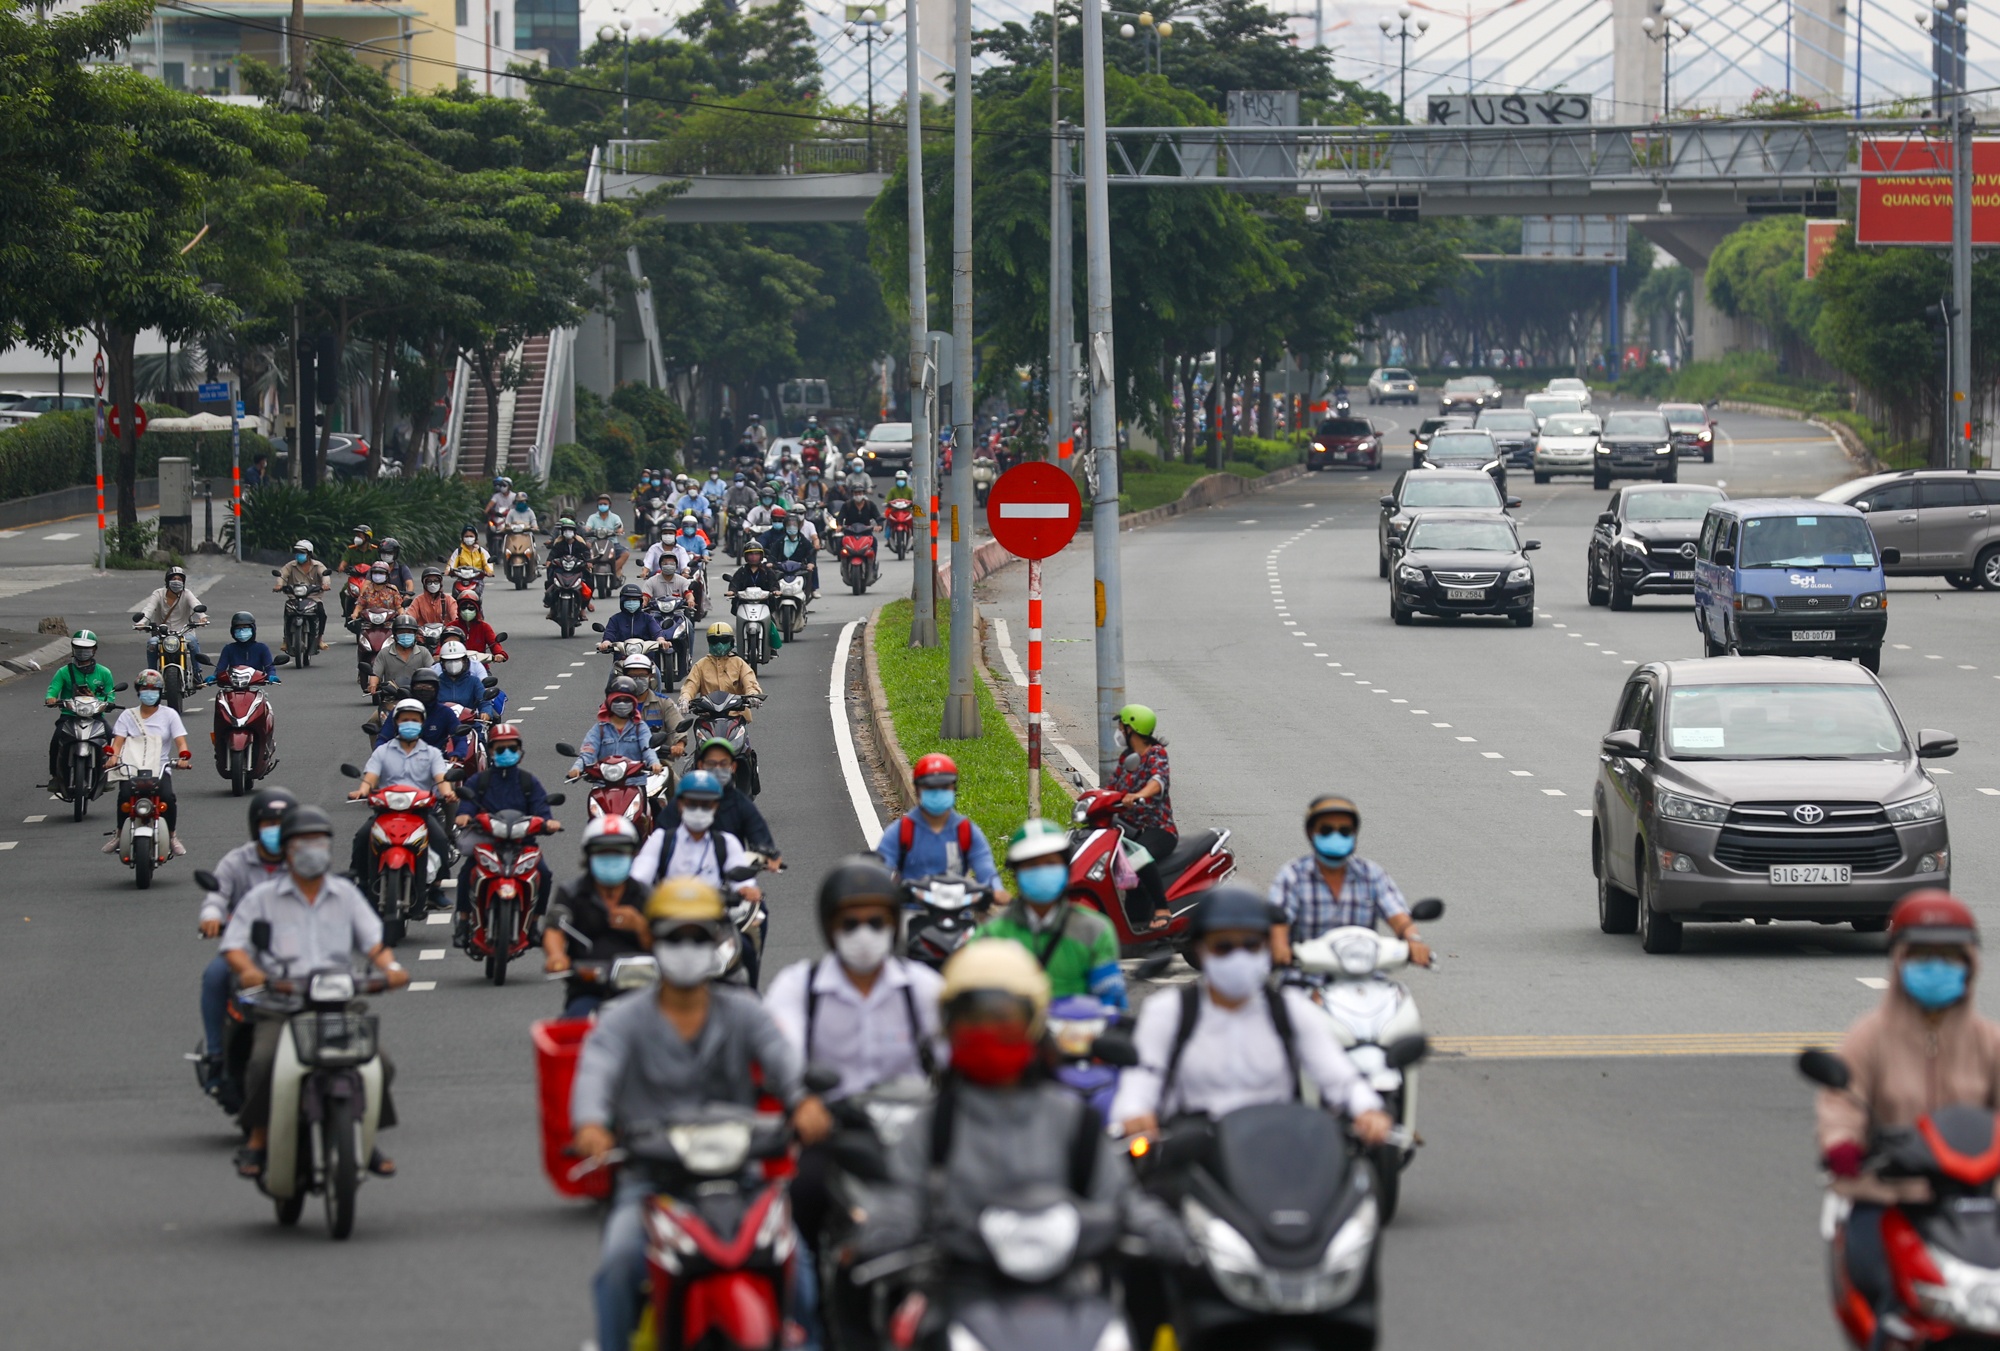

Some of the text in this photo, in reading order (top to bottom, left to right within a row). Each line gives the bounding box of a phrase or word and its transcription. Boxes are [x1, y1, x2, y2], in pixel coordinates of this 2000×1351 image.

[1882, 193, 1931, 208] QUANG
[1933, 193, 1954, 207] VIN
[1773, 867, 1849, 883] 51G-274.18
